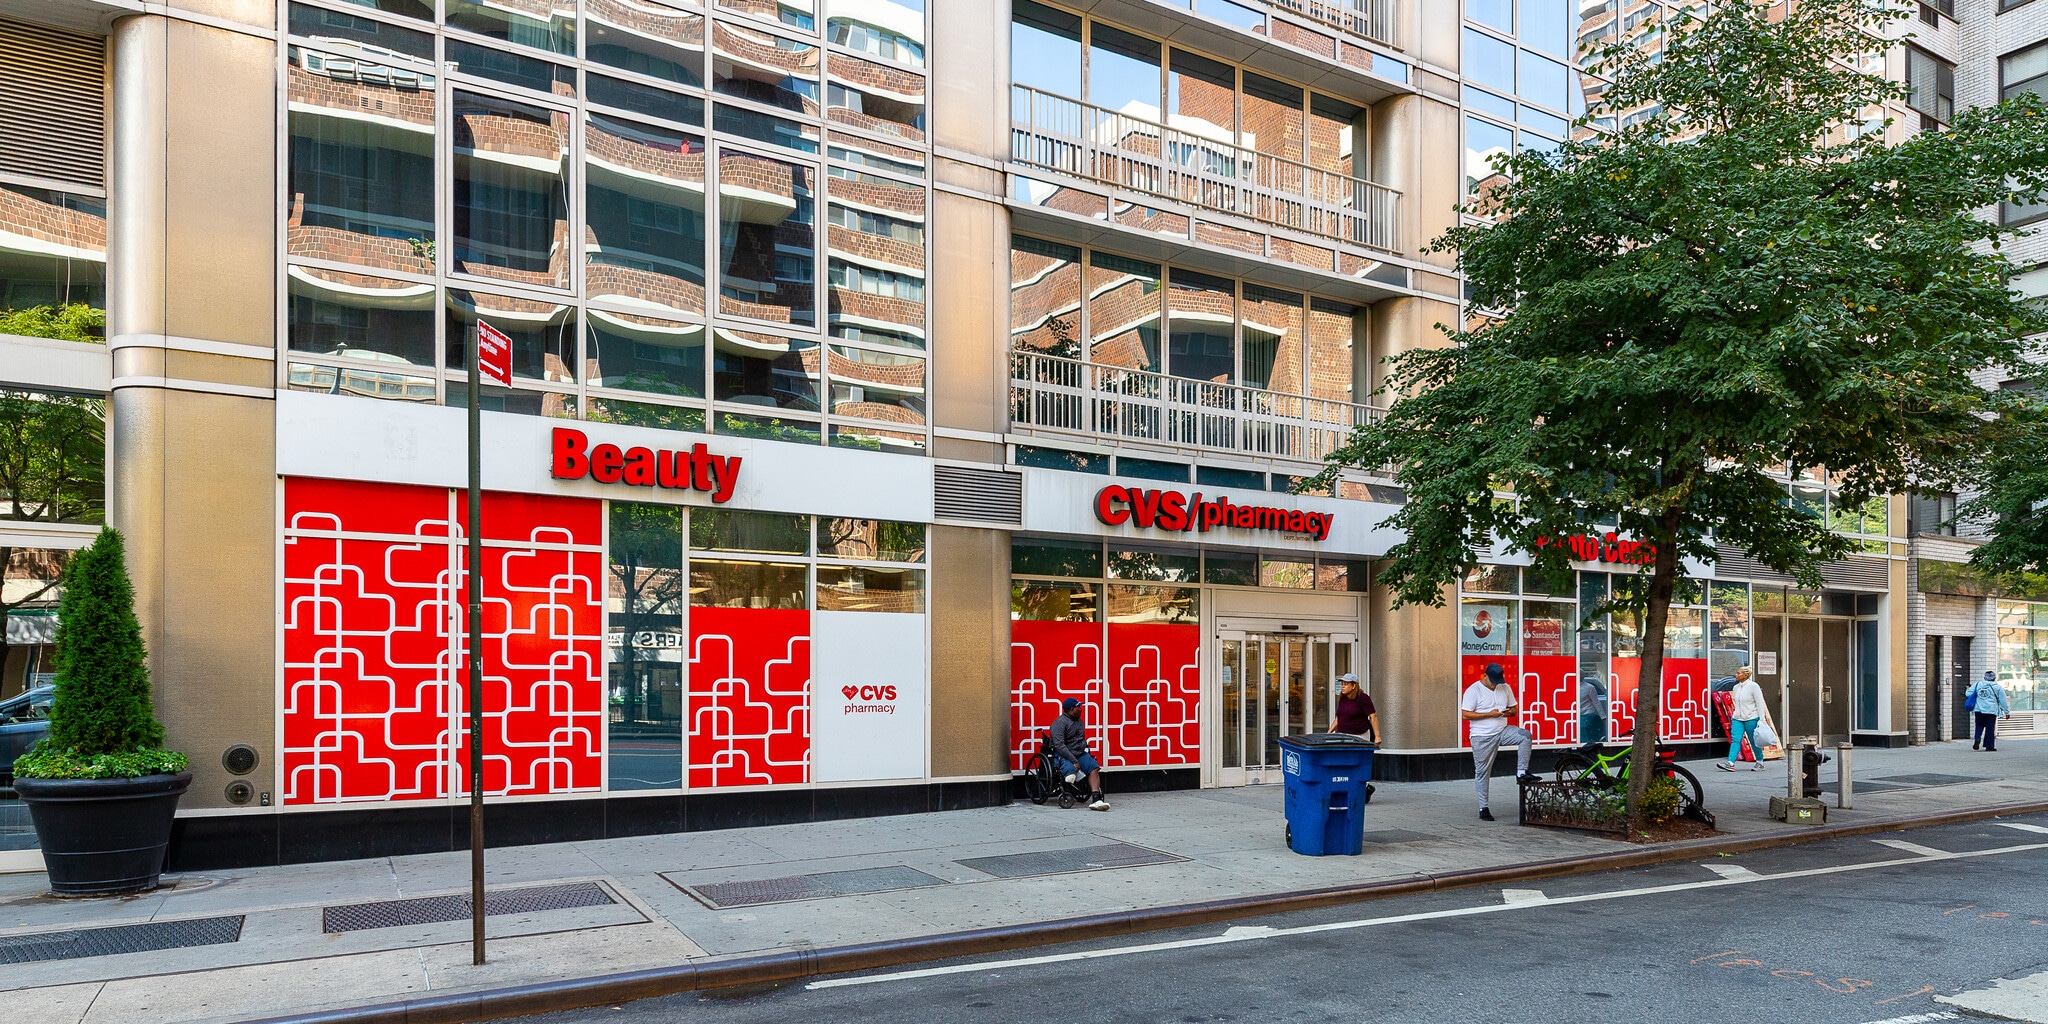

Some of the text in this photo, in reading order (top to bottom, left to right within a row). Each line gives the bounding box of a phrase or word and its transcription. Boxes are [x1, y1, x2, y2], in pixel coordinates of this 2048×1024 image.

[551, 427, 742, 503] Beauty
[1531, 630, 1560, 639] Santander
[1461, 642, 1503, 652] MoneyGram
[860, 685, 897, 701] CVS
[844, 703, 896, 715] pharmacy
